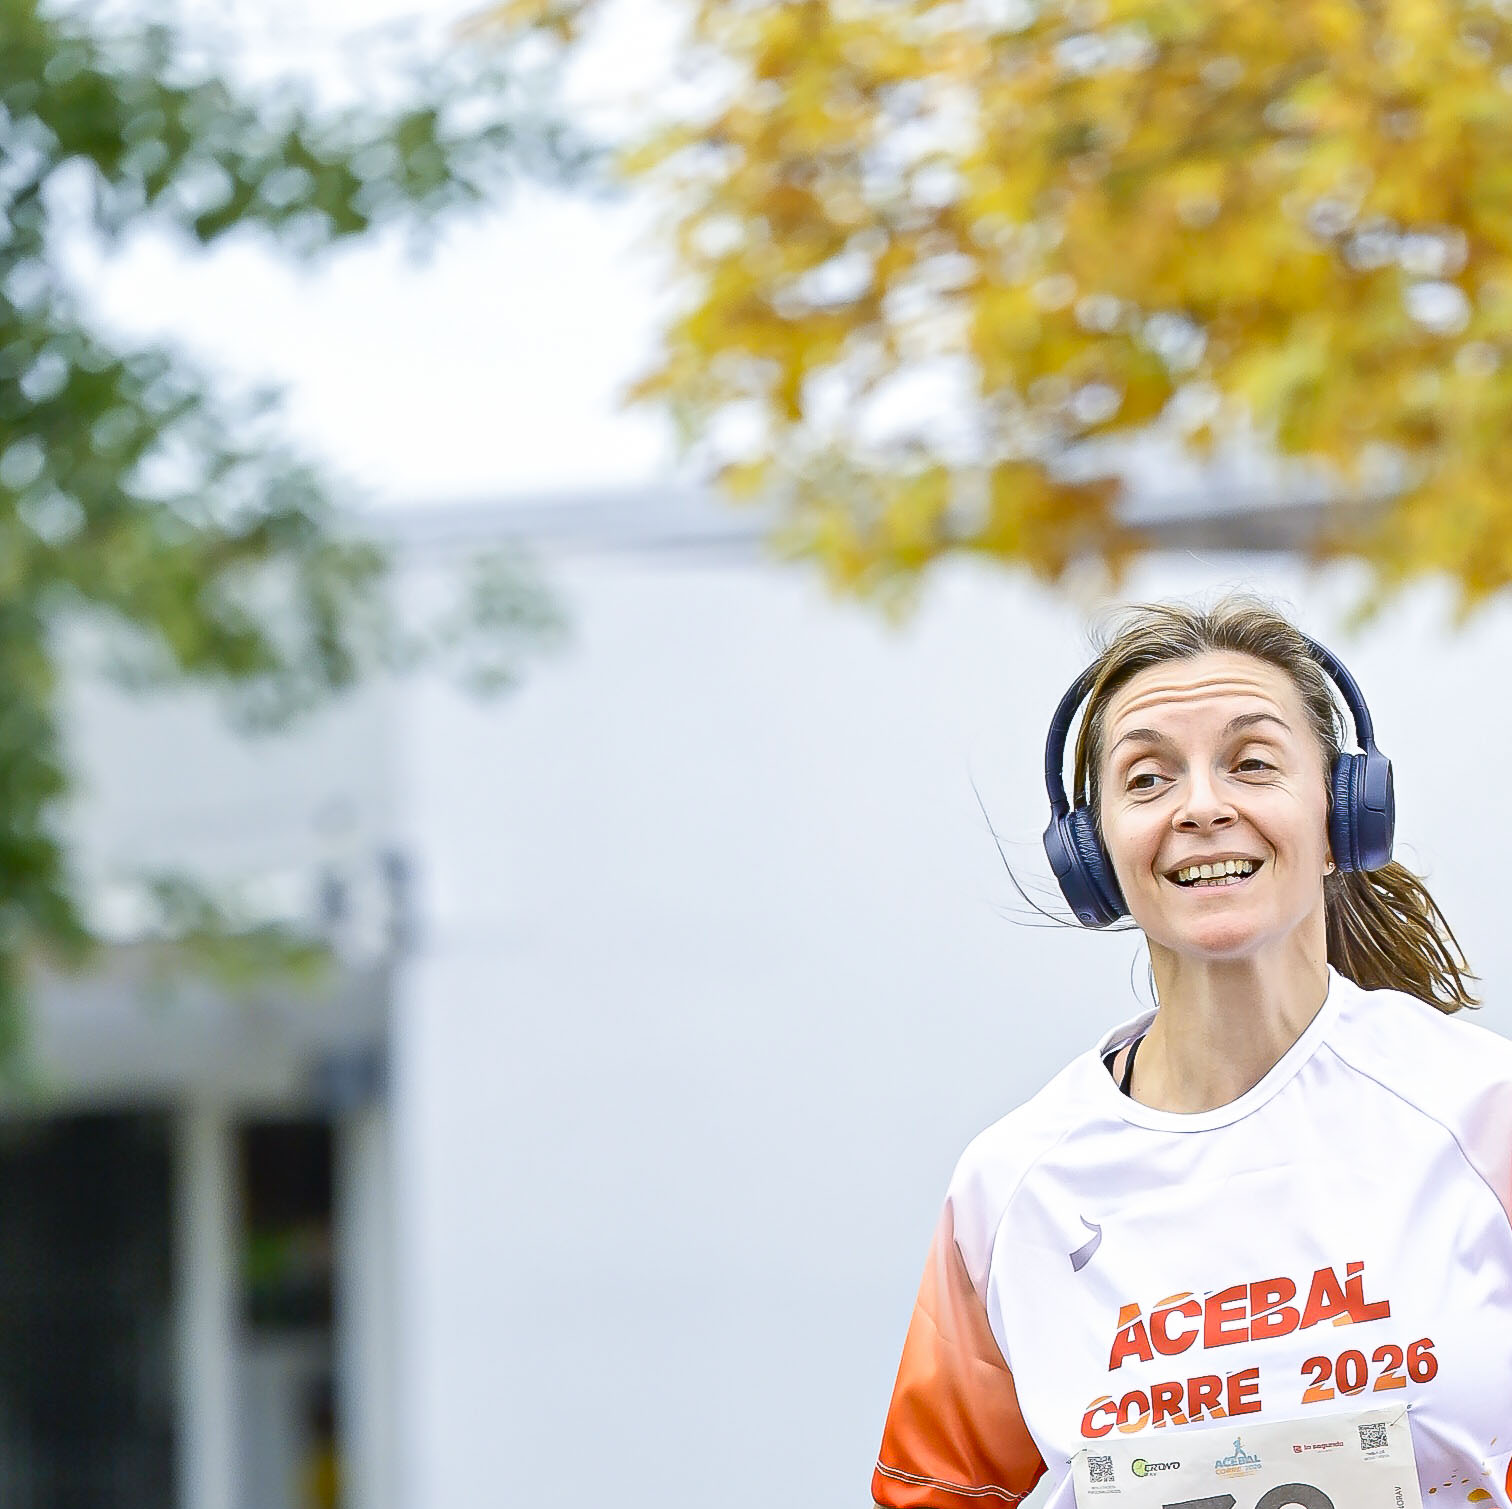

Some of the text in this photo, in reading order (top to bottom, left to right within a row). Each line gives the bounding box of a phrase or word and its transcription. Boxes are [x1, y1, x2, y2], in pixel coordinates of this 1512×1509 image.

[1108, 1261, 1391, 1371] ACEBAL
[1081, 1338, 1439, 1438] CORRE 2026
